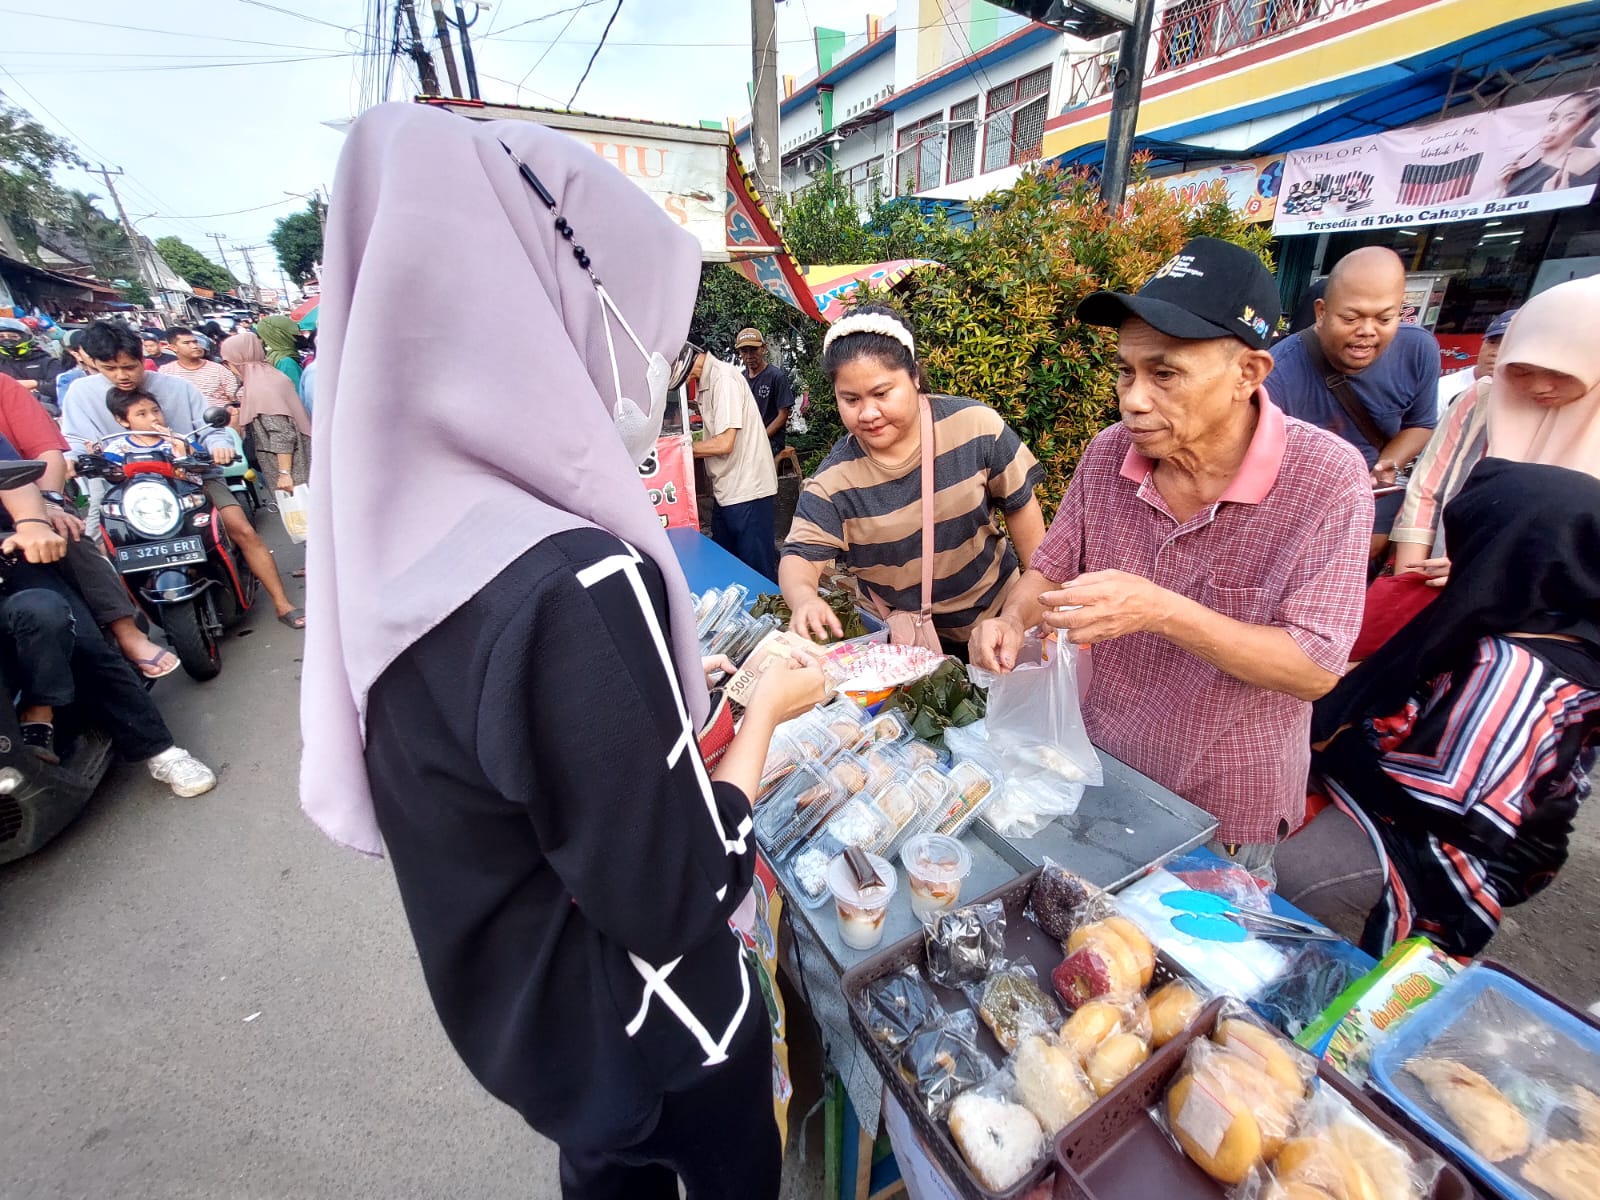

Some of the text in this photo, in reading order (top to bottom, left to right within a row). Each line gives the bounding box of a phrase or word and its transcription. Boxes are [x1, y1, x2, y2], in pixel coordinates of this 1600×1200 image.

[1293, 144, 1379, 165] IMPLORA
[1307, 200, 1530, 231] Tersedia di Toko Cahaya Baru
[120, 540, 197, 561] B 3276 ERT
[731, 669, 755, 695] 5000
[1393, 972, 1431, 1003] Cling
